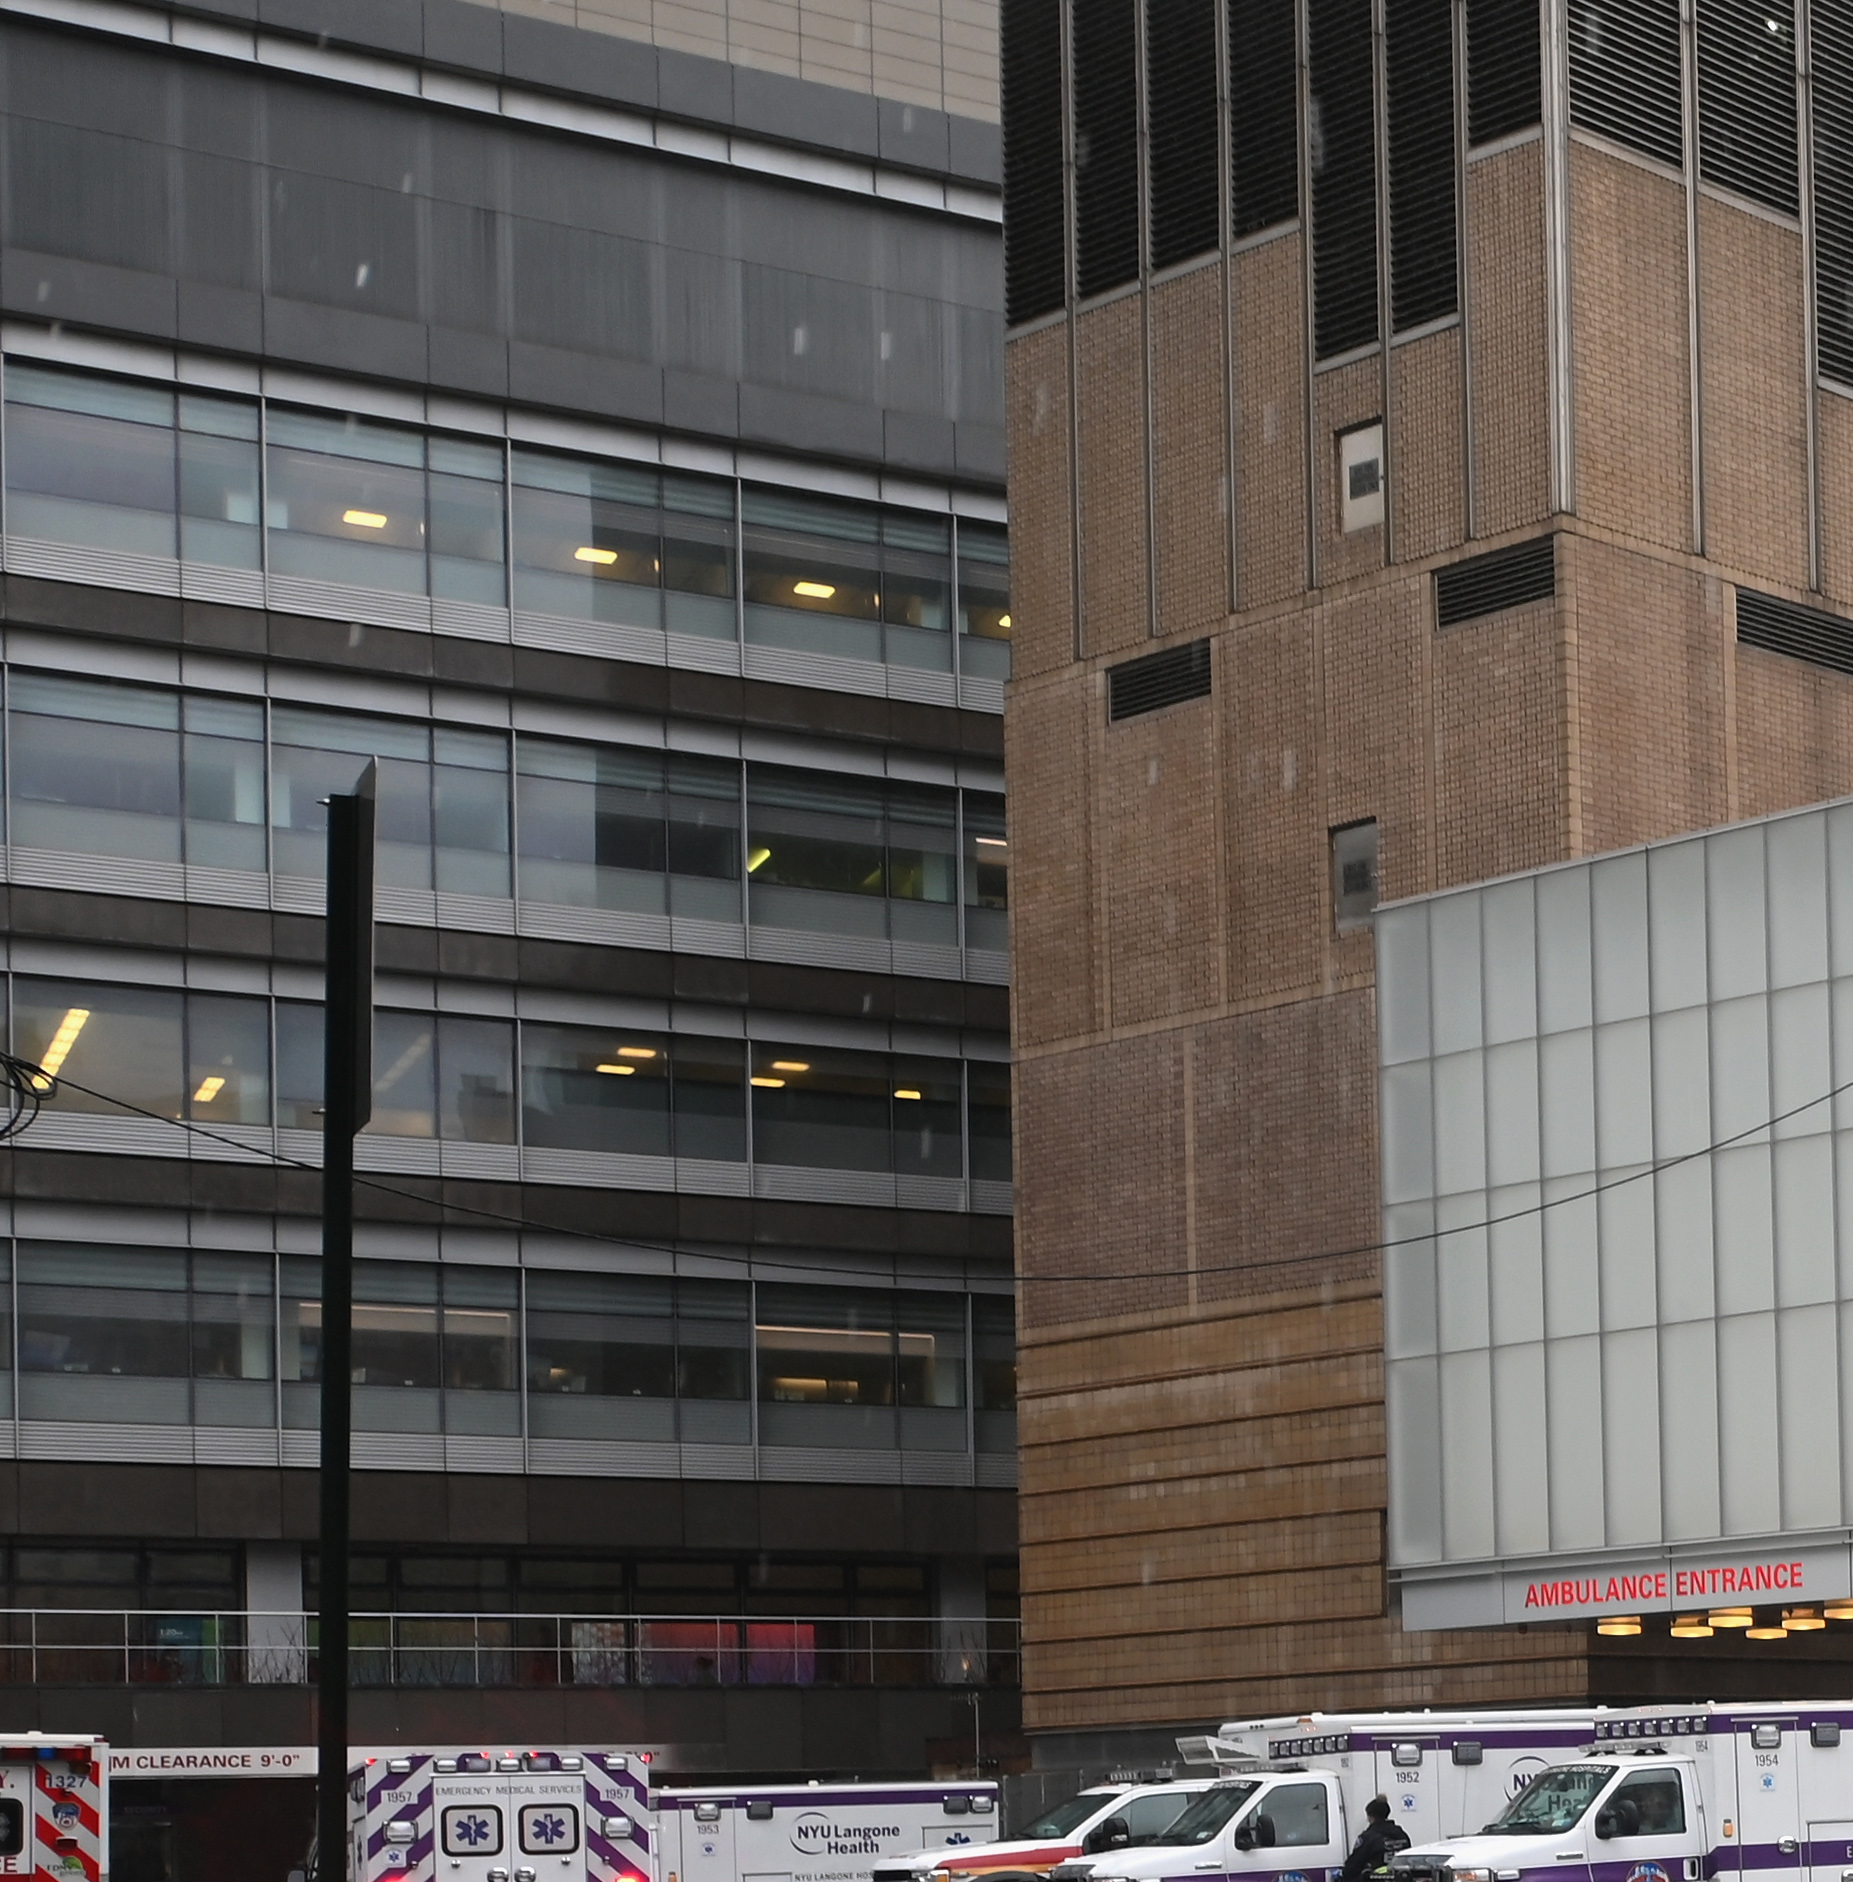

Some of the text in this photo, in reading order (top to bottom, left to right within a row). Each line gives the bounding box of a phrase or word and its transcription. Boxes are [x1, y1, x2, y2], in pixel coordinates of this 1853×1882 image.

[1524, 1562, 1804, 1608] AMBULANCE ENTRANCE
[136, 1755, 252, 1769] CLEARANCE
[1755, 1753, 1779, 1767] 1954
[45, 1774, 87, 1789] 1327
[1395, 1772, 1420, 1783] 1952
[435, 1783, 582, 1796] EMERGENCY MEDICAL SERVICES
[605, 1788, 630, 1800] 1957
[386, 1791, 413, 1803] 1957
[697, 1824, 720, 1835] 1953
[797, 1824, 901, 1840] NYU Langone
[827, 1840, 880, 1855] Health
[795, 1874, 813, 1882] NYU
[814, 1872, 854, 1882] LANGONE
